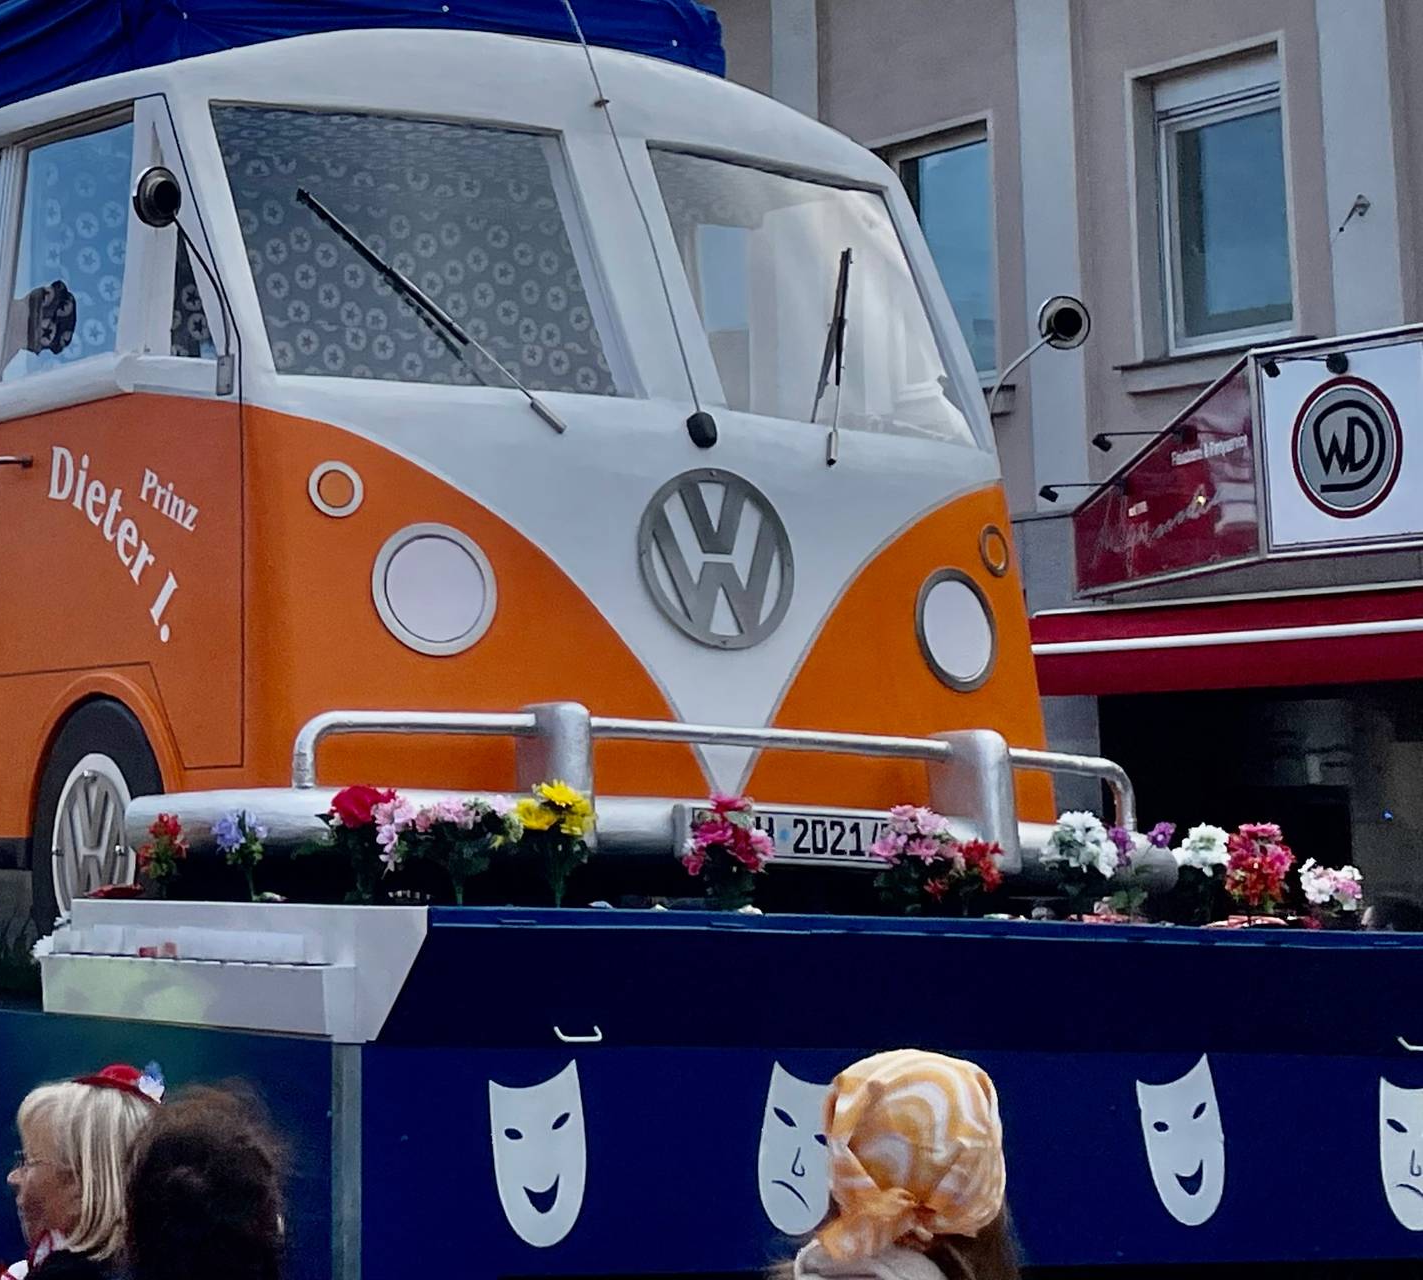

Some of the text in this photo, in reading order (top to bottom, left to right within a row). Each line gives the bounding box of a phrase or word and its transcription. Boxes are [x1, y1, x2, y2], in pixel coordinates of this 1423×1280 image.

[48, 446, 155, 585] Dieter
[140, 467, 199, 532] Prinz
[639, 468, 794, 651] VW
